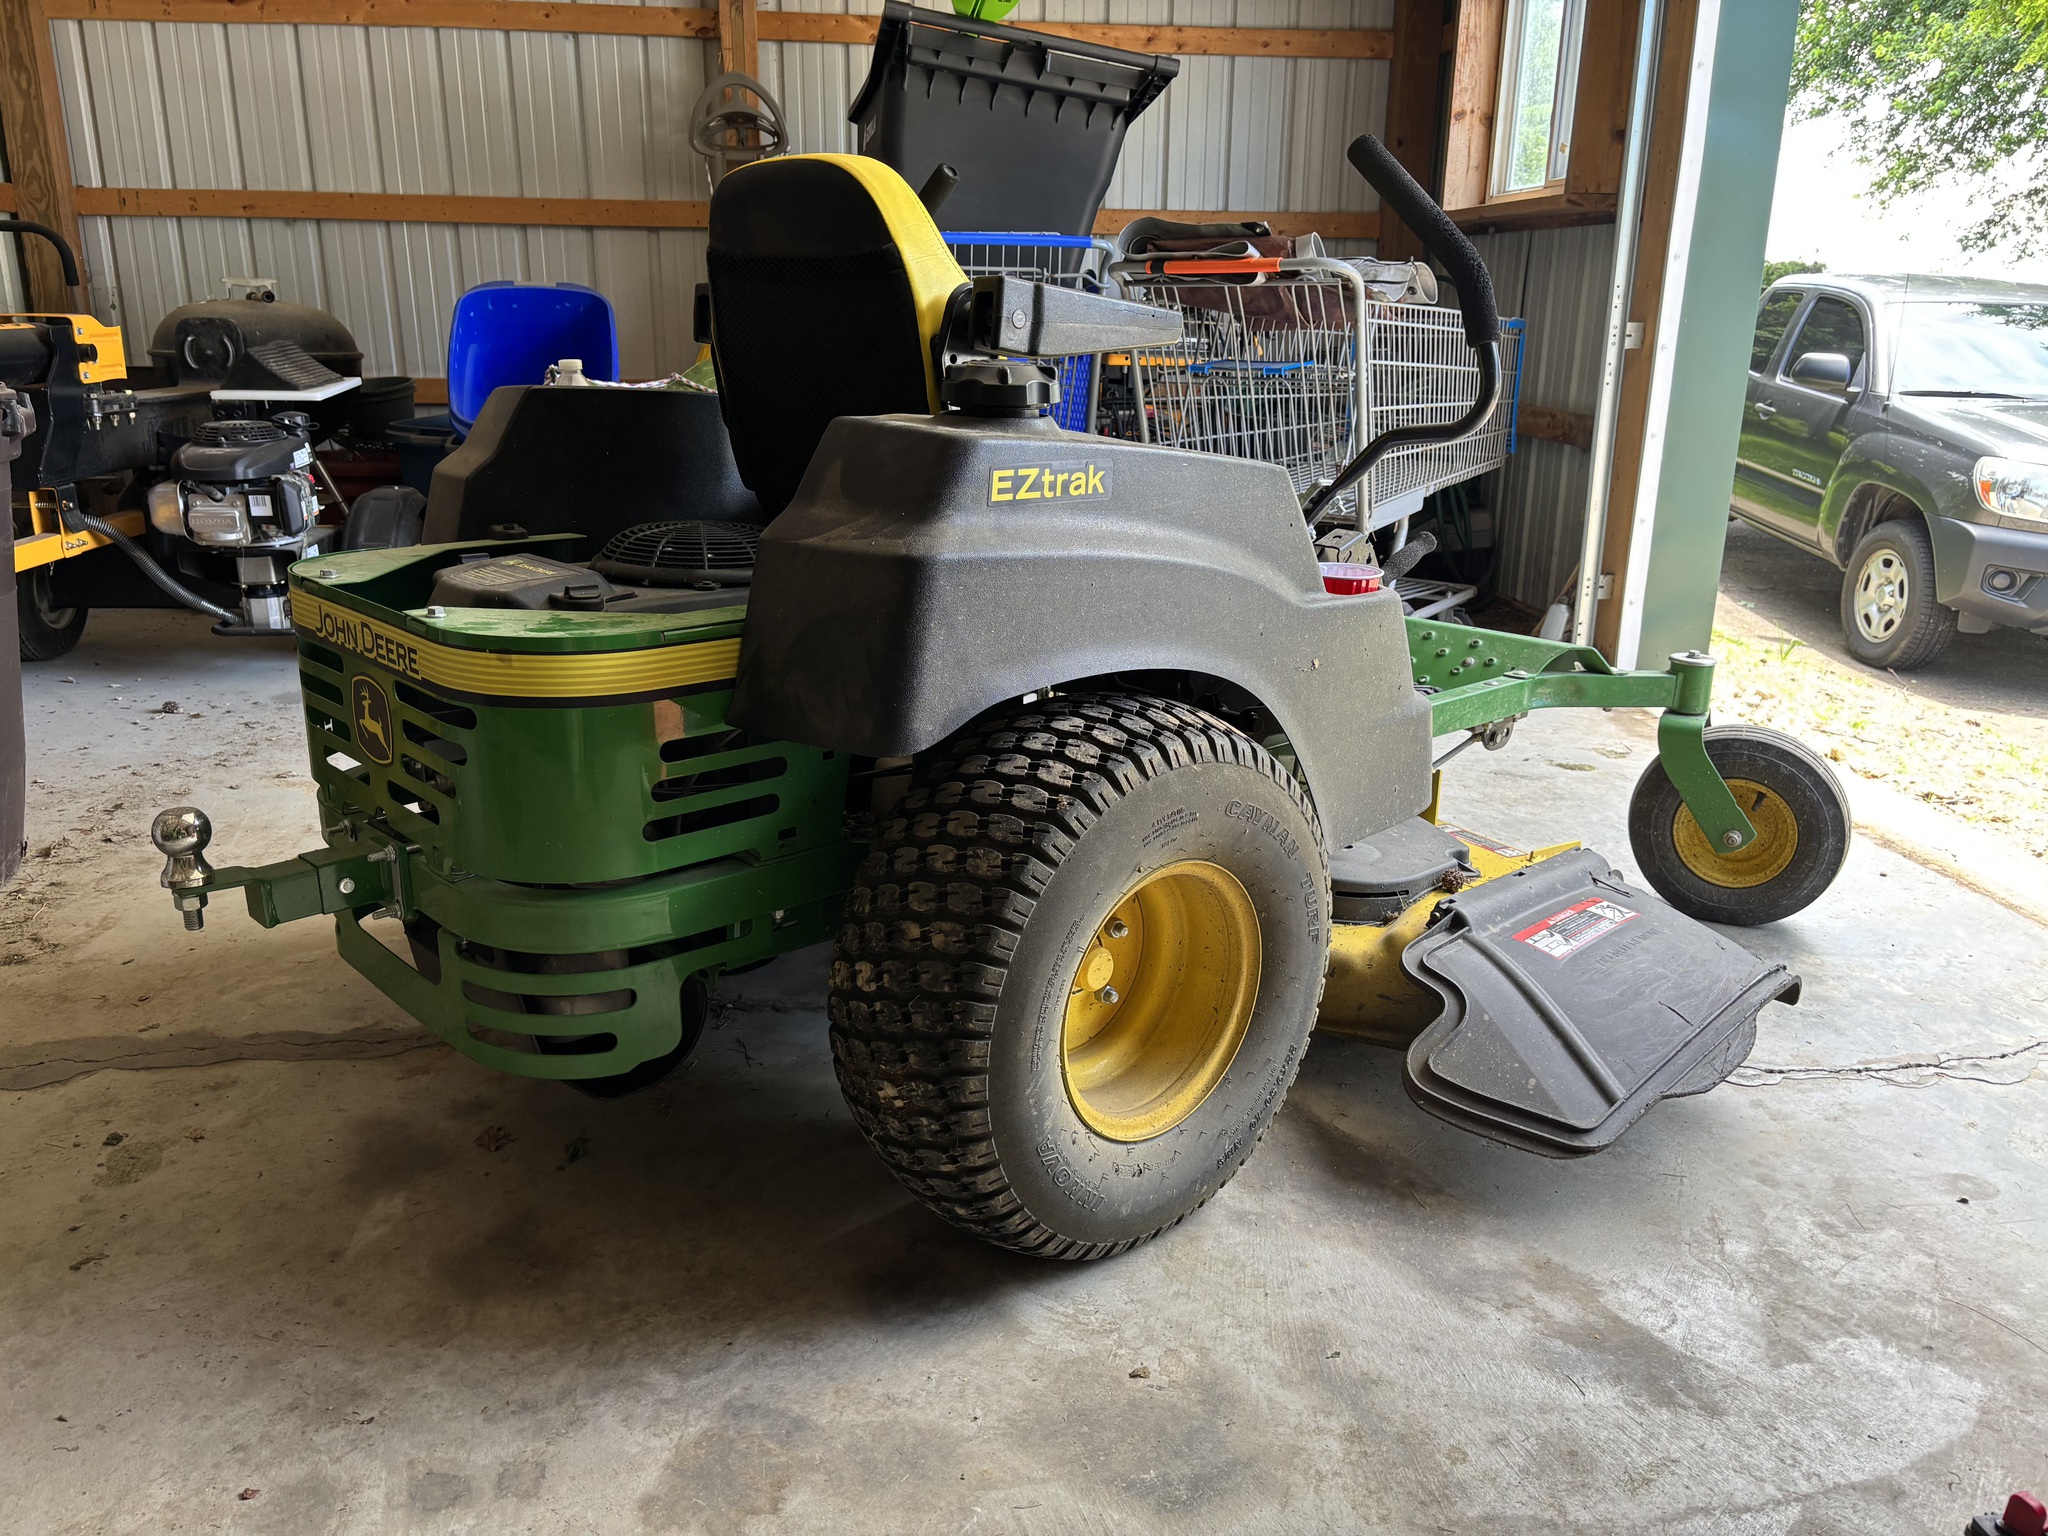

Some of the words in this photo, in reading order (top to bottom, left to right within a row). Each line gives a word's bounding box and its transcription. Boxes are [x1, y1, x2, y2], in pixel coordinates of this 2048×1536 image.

[190, 515, 235, 526] HONDA
[991, 465, 1106, 502] EZtrak
[315, 604, 360, 653] JOHN
[360, 621, 421, 679] DEERE
[1224, 799, 1301, 860] CAYMAN
[1300, 871, 1321, 945] TURF
[1036, 1134, 1107, 1212] INNOVA
